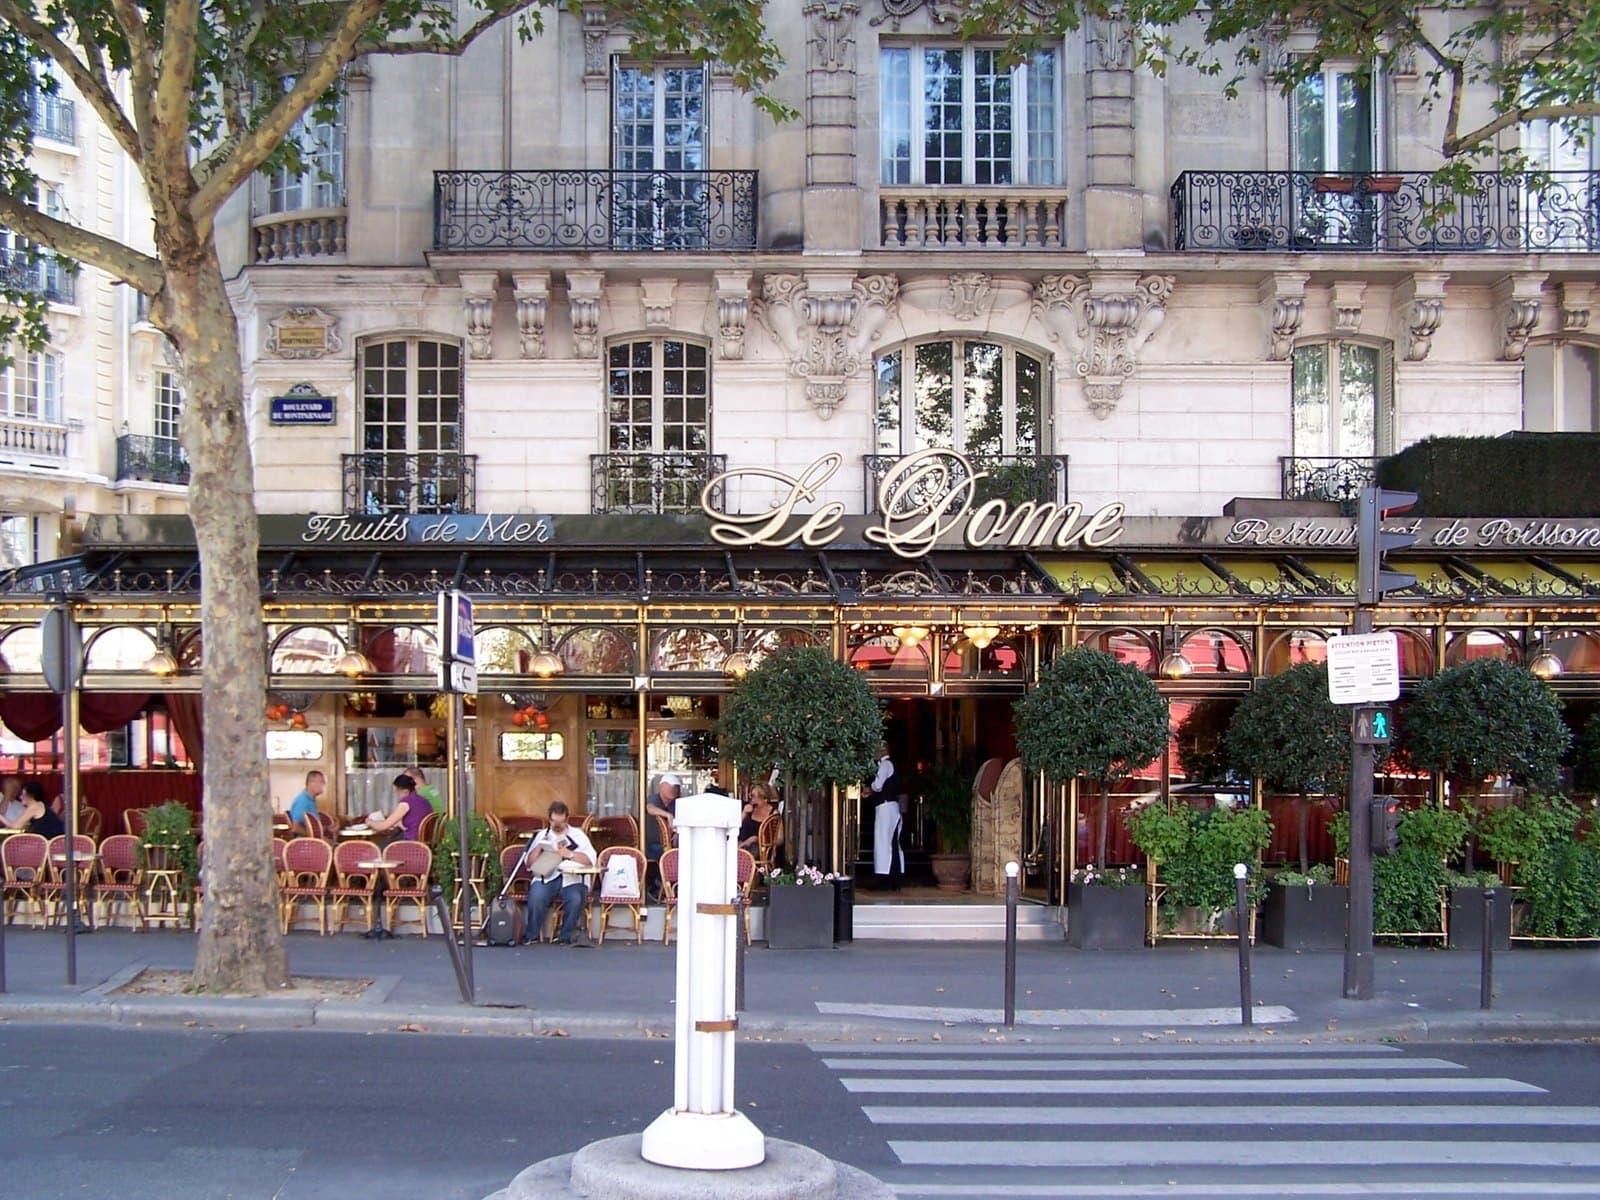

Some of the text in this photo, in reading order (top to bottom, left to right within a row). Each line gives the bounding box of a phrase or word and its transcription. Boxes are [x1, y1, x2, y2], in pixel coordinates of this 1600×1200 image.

[702, 447, 1126, 559] Le Dome
[301, 509, 550, 543] Fruits de Mer
[1226, 518, 1423, 547] Restaurt
[1435, 519, 1470, 545] de
